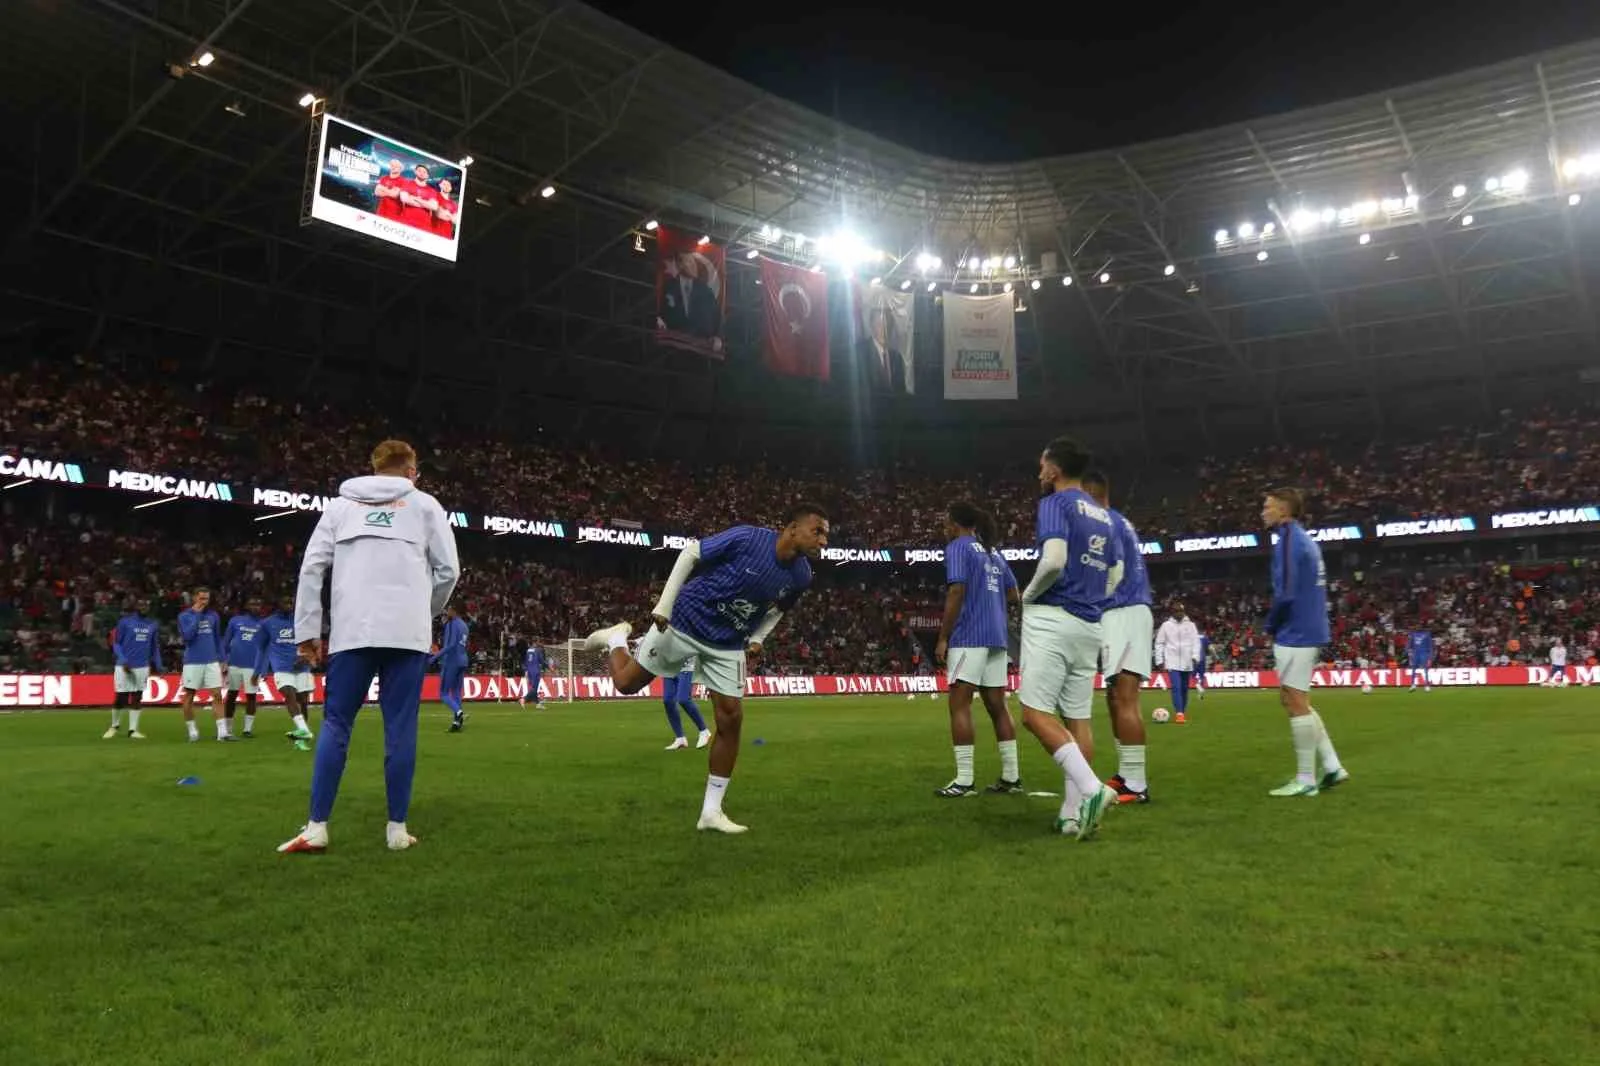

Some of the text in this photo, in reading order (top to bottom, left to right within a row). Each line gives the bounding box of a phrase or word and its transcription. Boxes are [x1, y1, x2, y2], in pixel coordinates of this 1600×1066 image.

[108, 469, 219, 499] MEDICANA
[483, 515, 556, 538] MEDICANA
[1491, 507, 1588, 529] MEDICANA
[578, 526, 642, 546] MEDICANA
[1376, 518, 1464, 537] MEDICANA
[1174, 535, 1248, 552] MEDICANA
[820, 547, 882, 561] MEDICANA
[765, 677, 815, 694] TWEEN
[836, 676, 938, 693] DAMAT TWEEN
[1203, 671, 1259, 688] WEEN
[1309, 669, 1392, 686] AMAT
[463, 676, 568, 698] DAMAT
